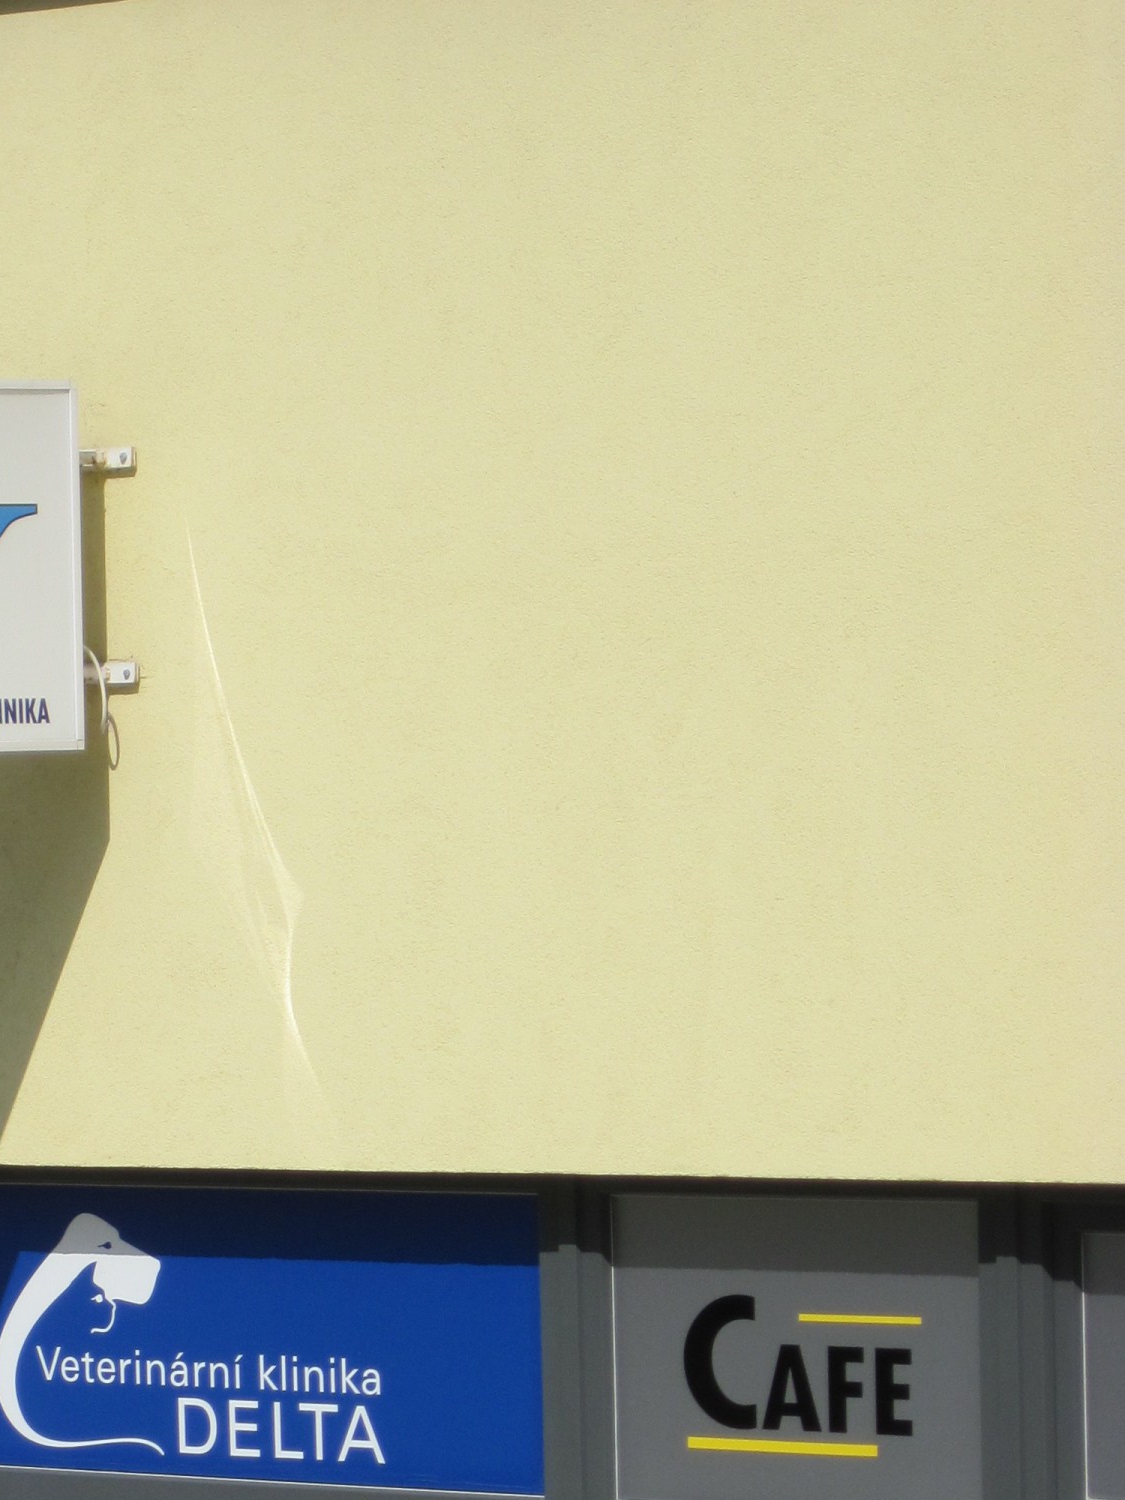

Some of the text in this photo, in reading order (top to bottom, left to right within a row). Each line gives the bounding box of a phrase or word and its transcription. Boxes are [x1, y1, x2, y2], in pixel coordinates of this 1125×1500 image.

[35, 1344, 382, 1396] Veterinární klinika
[683, 1294, 914, 1438] CAFE
[177, 1396, 386, 1465] DELTA
